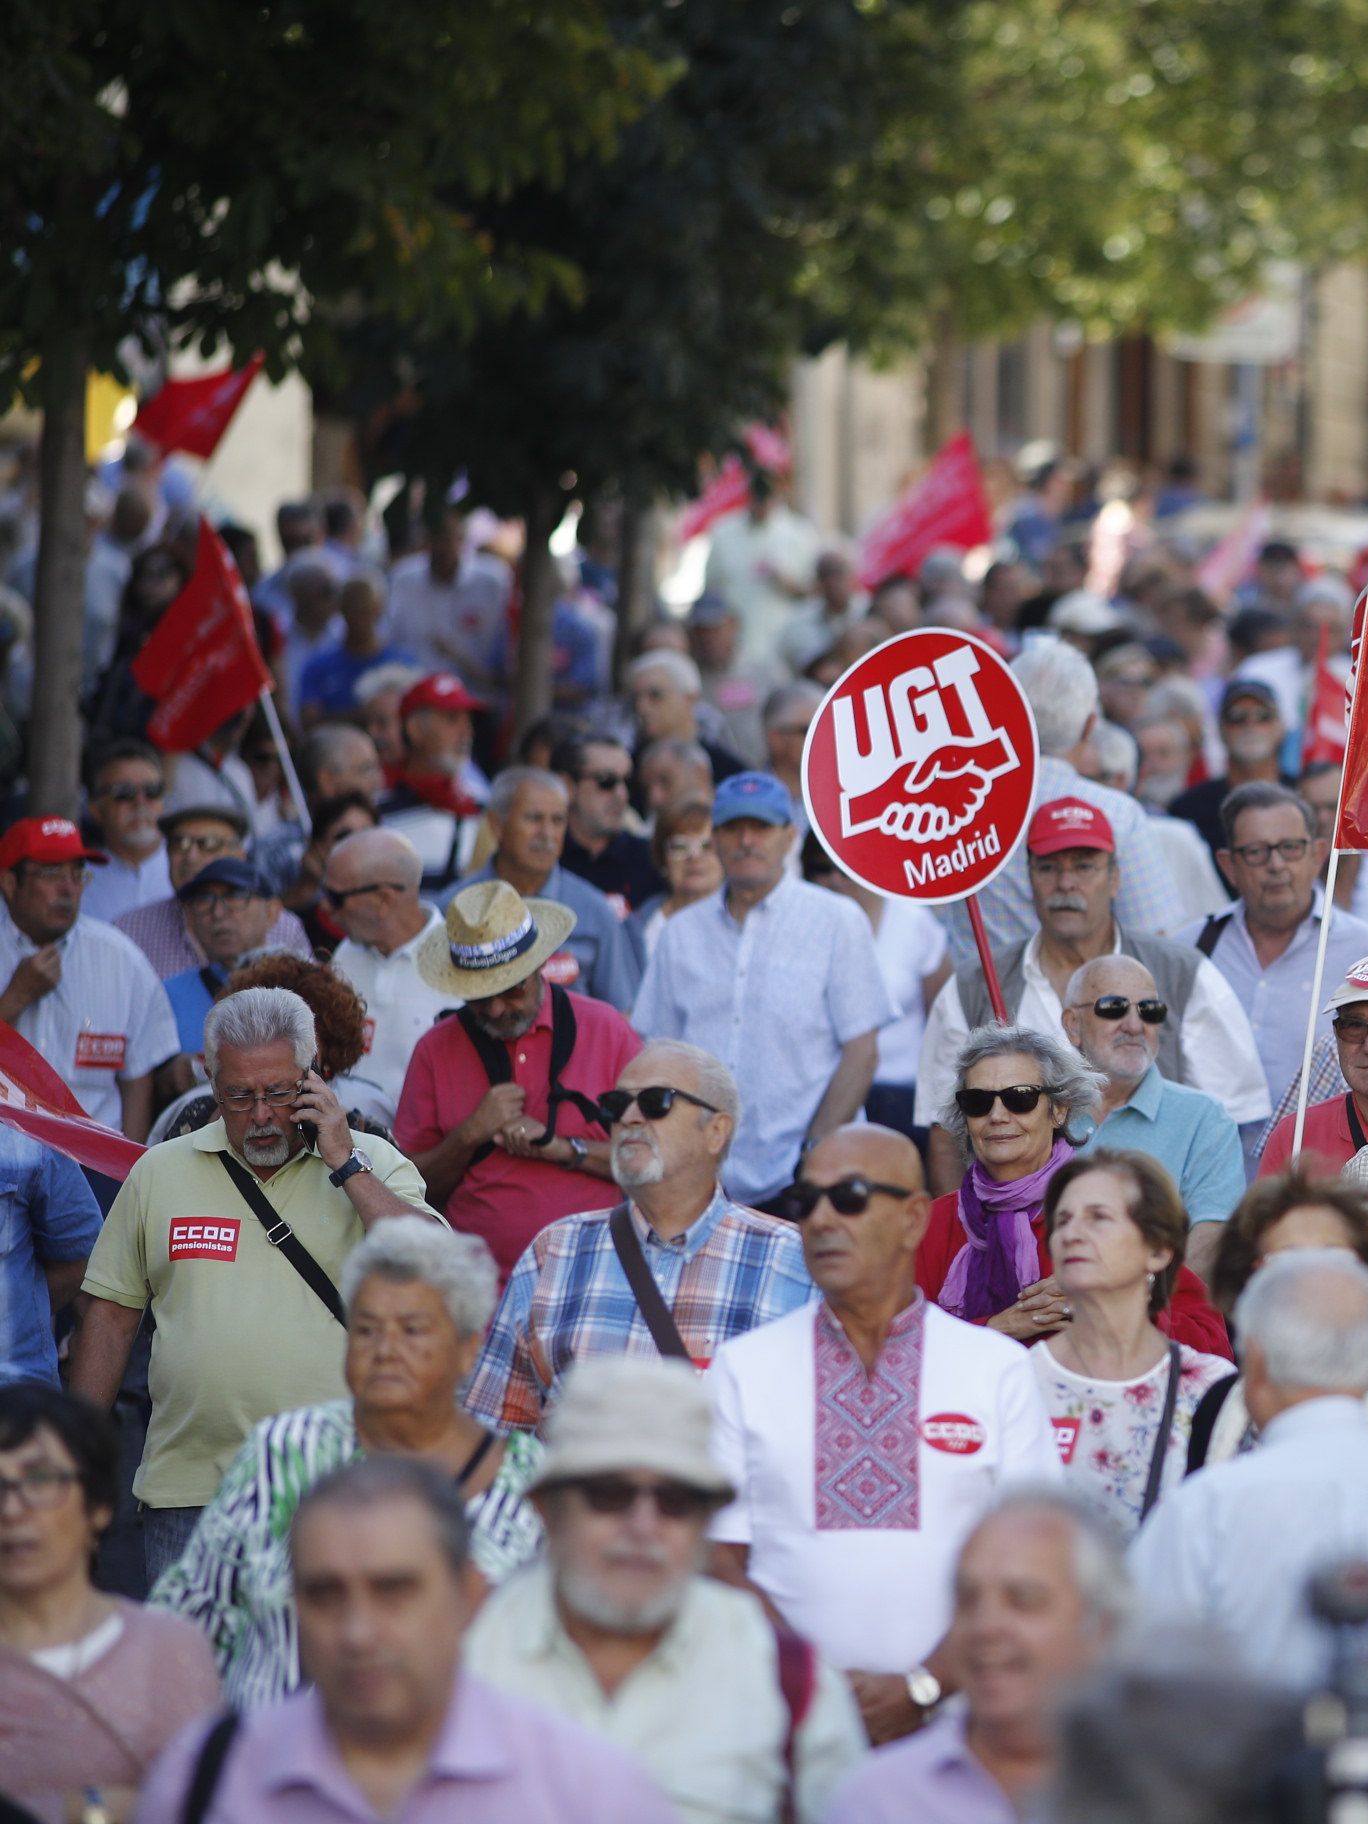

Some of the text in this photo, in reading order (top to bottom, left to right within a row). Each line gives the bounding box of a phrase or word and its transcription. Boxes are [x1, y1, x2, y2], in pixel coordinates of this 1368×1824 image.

[832, 644, 995, 798] UGT
[902, 823, 1002, 890] Madrid
[171, 1241, 233, 1252] pensionistas
[173, 1225, 236, 1242] CCOO
